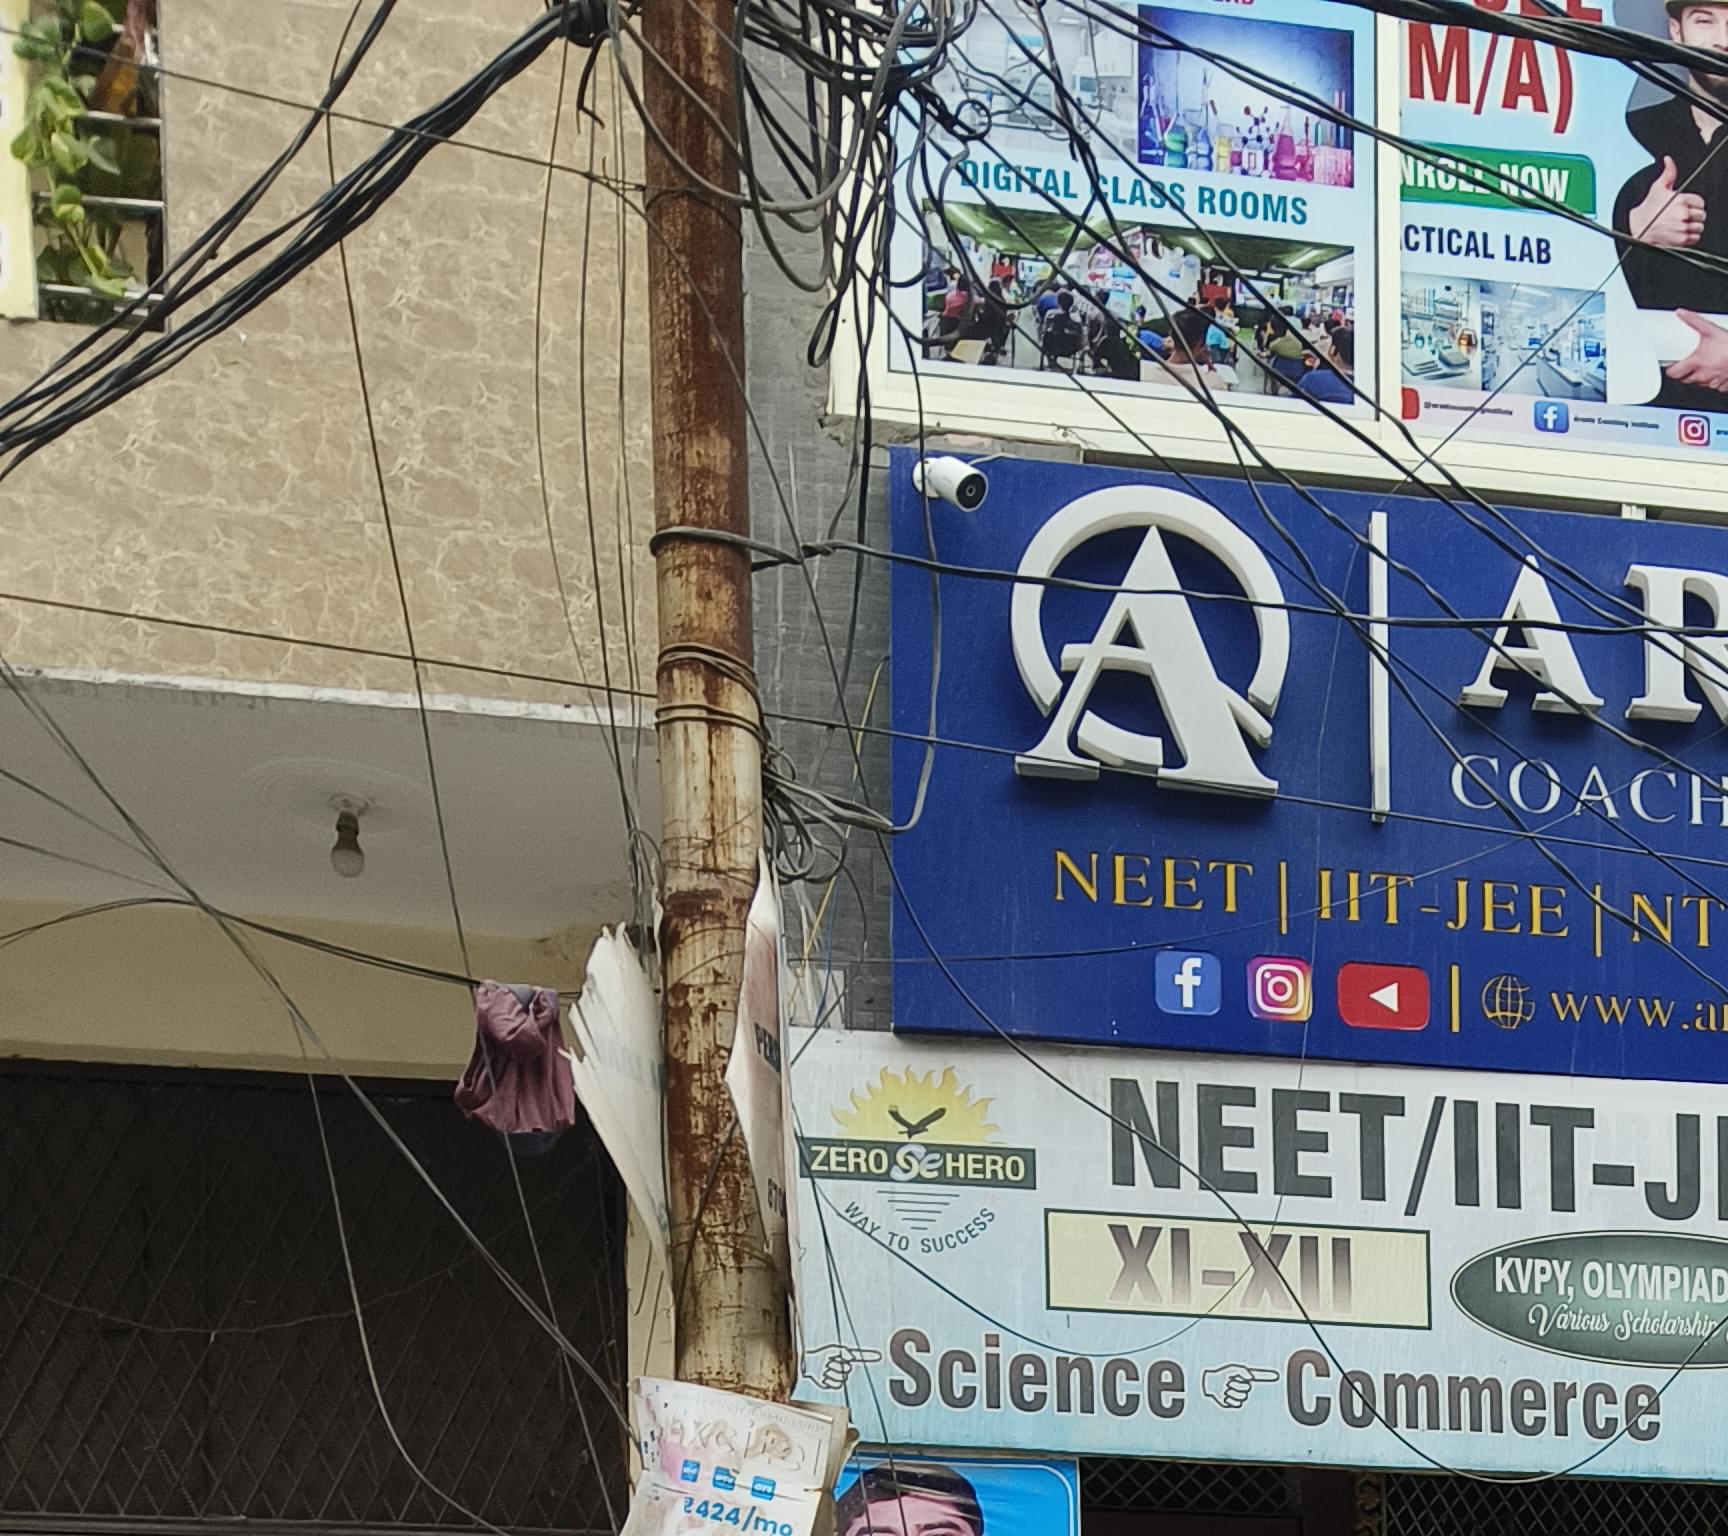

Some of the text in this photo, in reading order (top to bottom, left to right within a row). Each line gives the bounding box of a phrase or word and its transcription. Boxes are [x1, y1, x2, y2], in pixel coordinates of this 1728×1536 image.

[959, 158, 1308, 226] DIGITAL CLASS ROOMS
[1400, 153, 1569, 203] NROLL NOW
[1401, 223, 1552, 266] CTICAL LAB
[1053, 849, 1254, 914] NEET
[1317, 868, 1570, 938] IIT-JEE
[810, 1145, 889, 1175] ZERO
[945, 1152, 1026, 1182] HERO
[845, 1201, 996, 1254] WAY TO SUCCESS
[1108, 1223, 1354, 1315] XI-XII
[1494, 1256, 1574, 1304] KVPY,
[1528, 1302, 1610, 1337] Various
[1614, 1308, 1719, 1345] Scholarship
[888, 1326, 1662, 1441] Science Commerce
